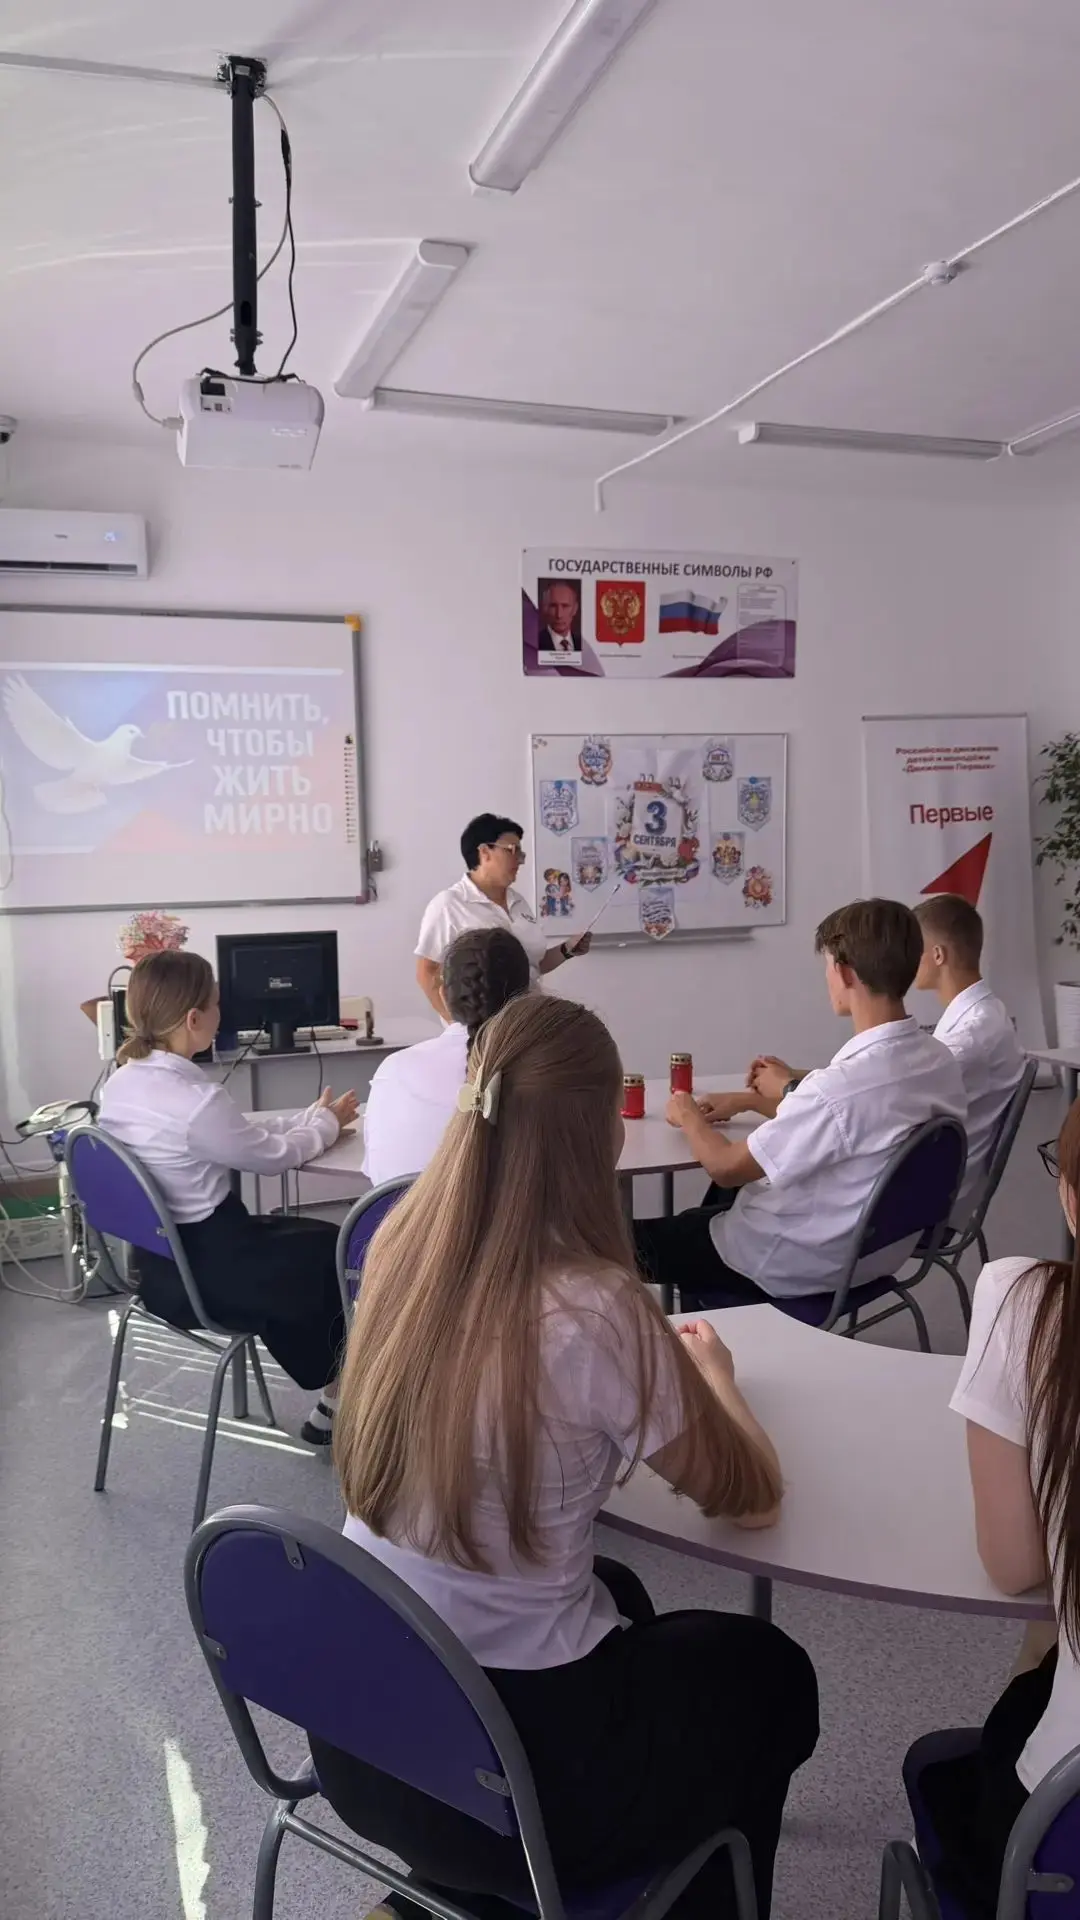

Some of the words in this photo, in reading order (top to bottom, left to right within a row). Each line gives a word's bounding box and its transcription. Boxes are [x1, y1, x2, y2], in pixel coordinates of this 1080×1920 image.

[548, 558, 680, 576] ГОСУДАРСТВЕННЫЕ
[683, 563, 752, 578] СИМВОЛЫ
[755, 566, 773, 579] РФ
[166, 690, 331, 725] ПОМНИТЬ,
[206, 728, 314, 757] ЧТОБЫ
[213, 765, 312, 796] ЖИТЬ
[203, 801, 333, 836] МИРНО
[644, 800, 668, 836] 3
[909, 804, 993, 829] Первые
[633, 834, 677, 848] СЕНТЯБРЯ
